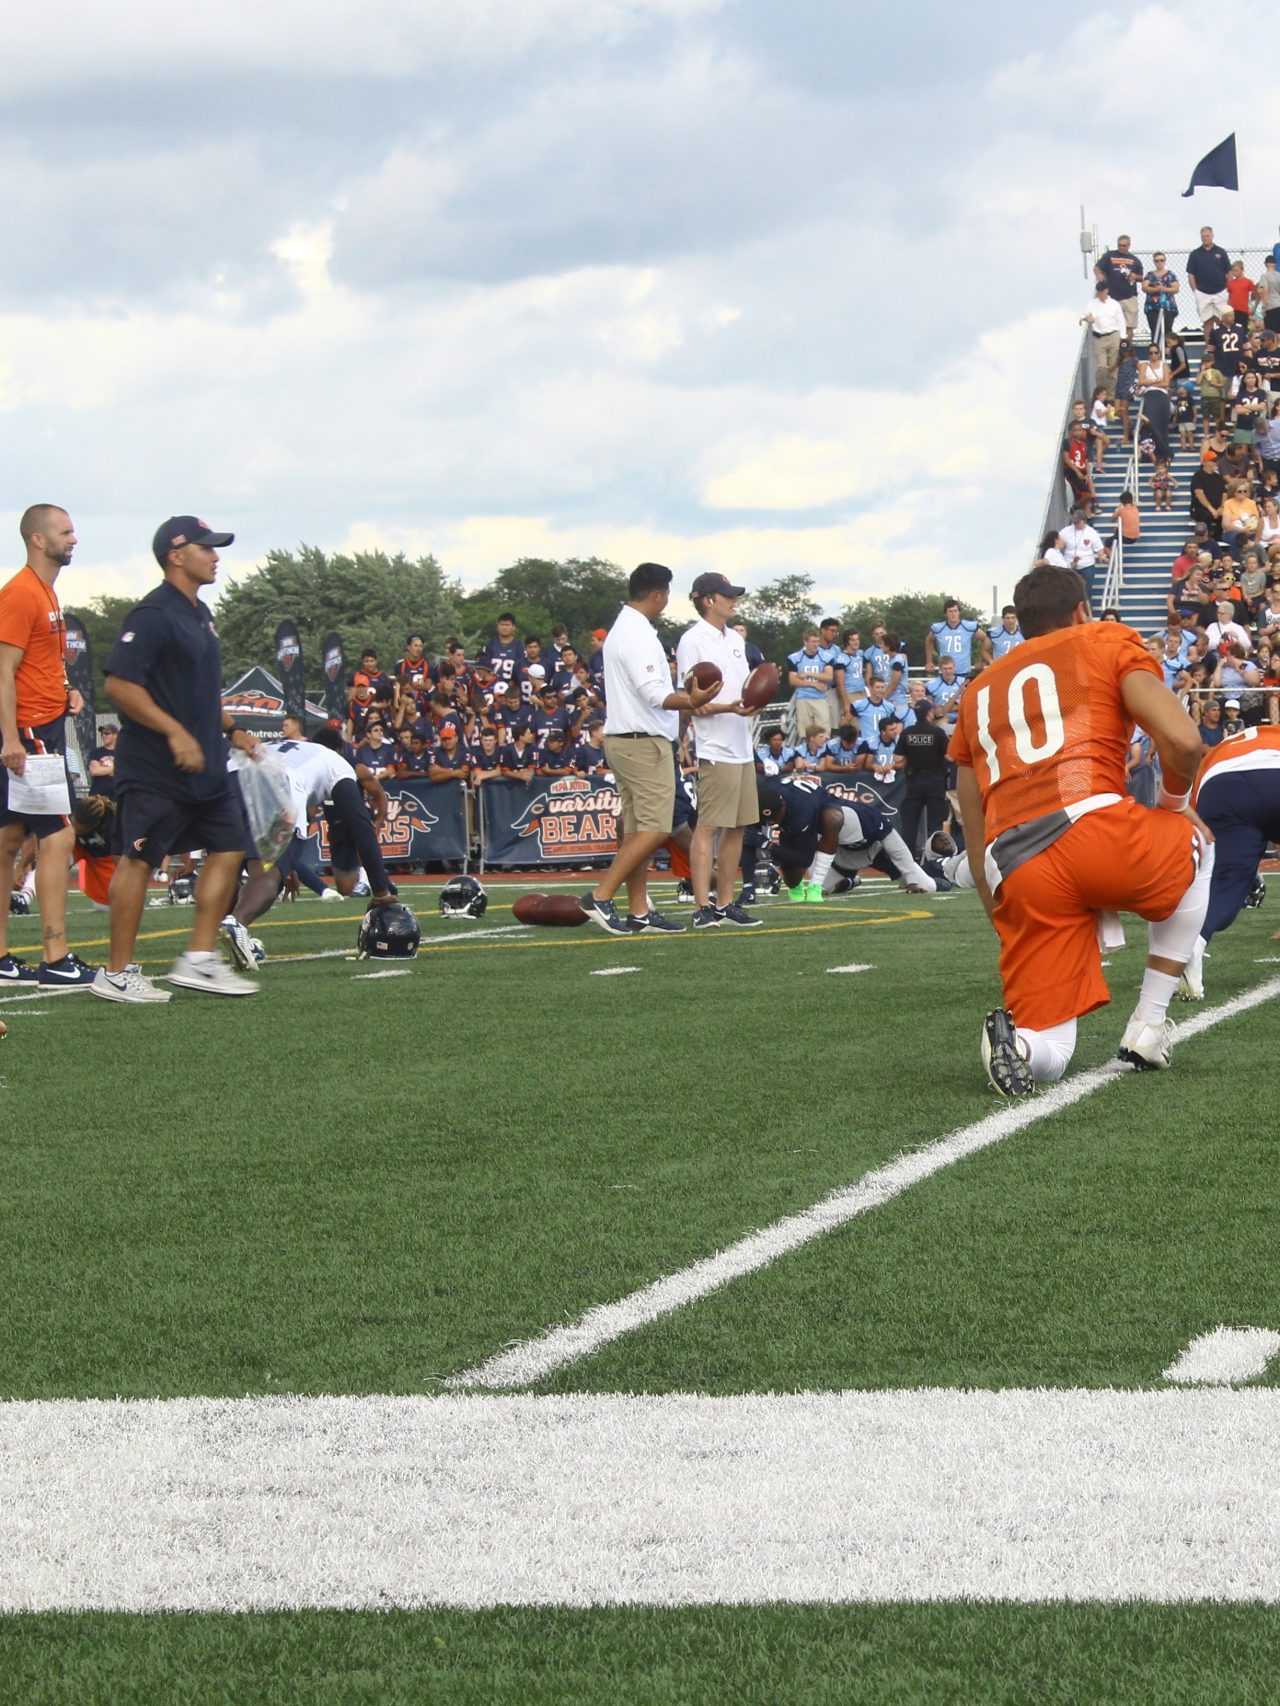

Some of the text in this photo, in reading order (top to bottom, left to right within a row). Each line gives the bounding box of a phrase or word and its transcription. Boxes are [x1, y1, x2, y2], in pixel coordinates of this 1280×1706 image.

[1221, 333, 1239, 352] 22
[943, 635, 962, 653] 76
[491, 658, 515, 679] 79
[875, 654, 890, 673] 33
[976, 662, 1065, 785] 10
[908, 735, 932, 744] POLICE
[548, 791, 622, 817] varsity
